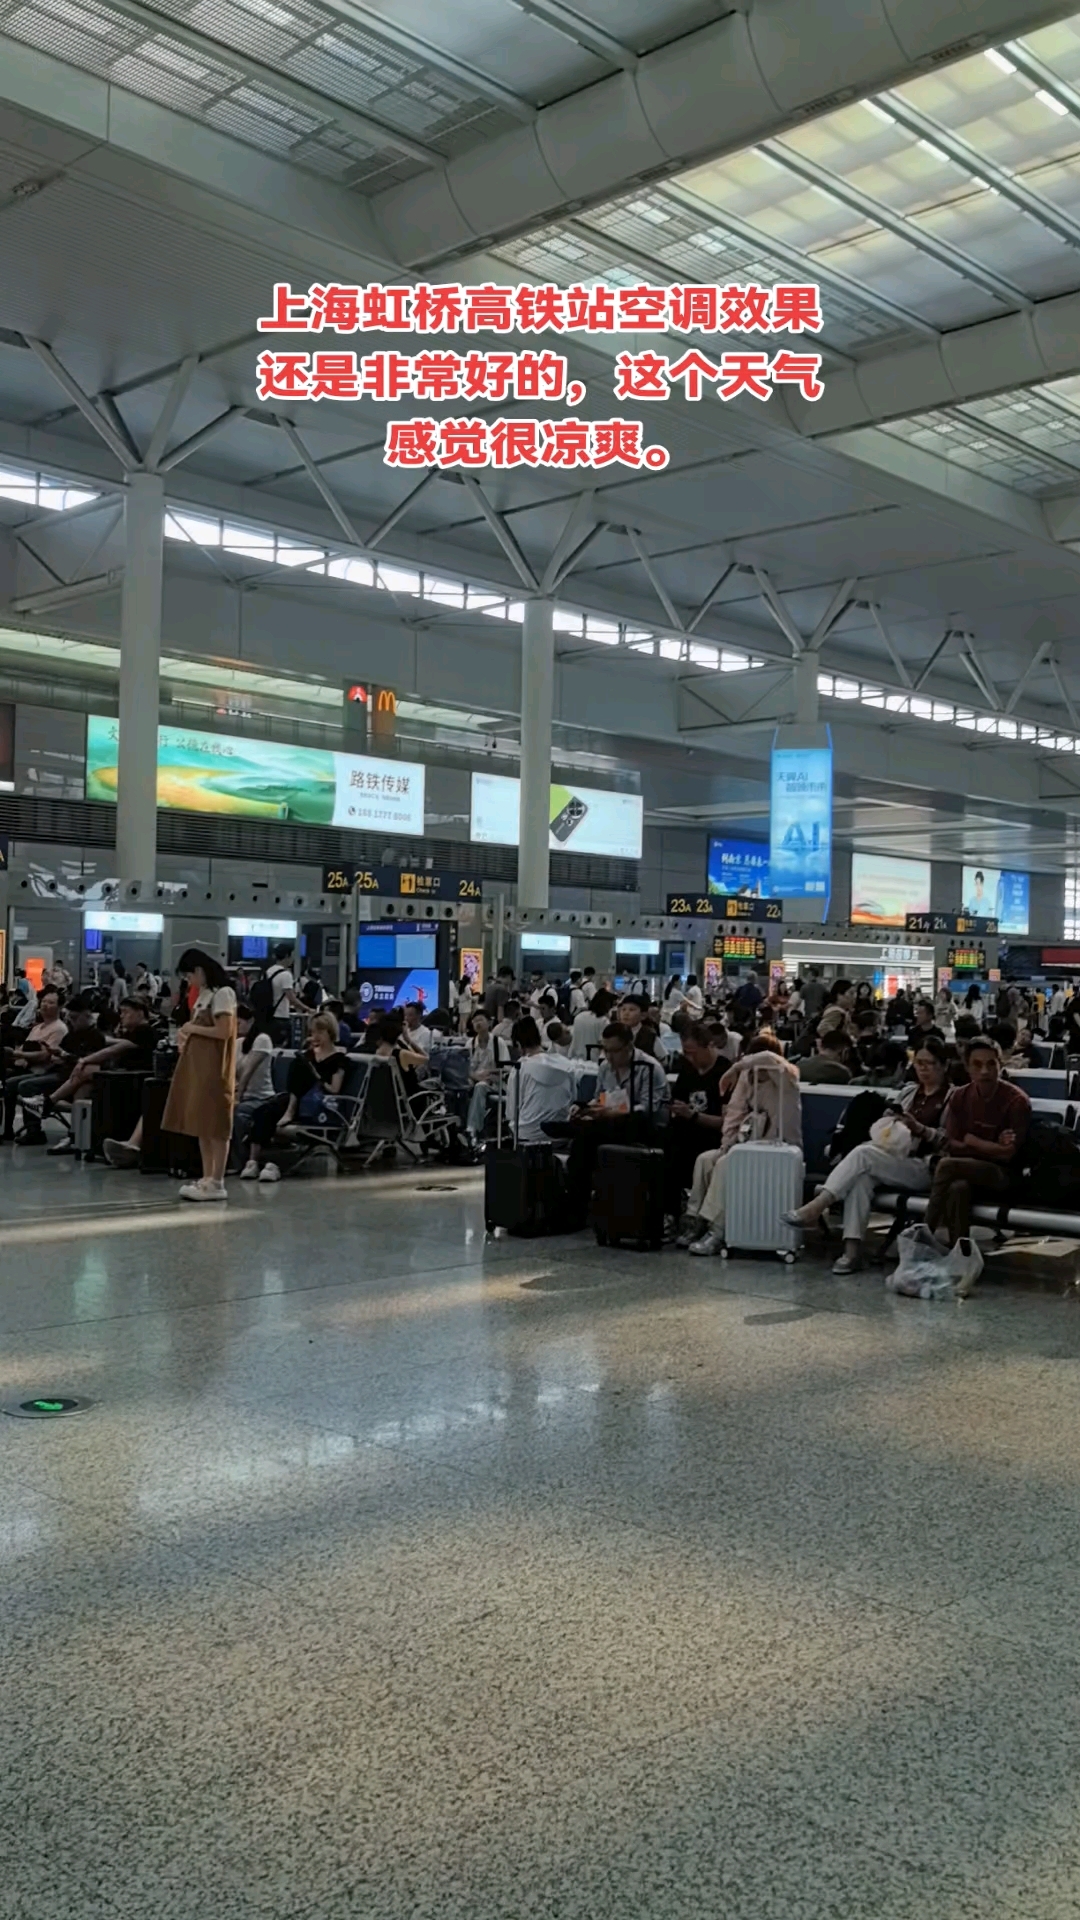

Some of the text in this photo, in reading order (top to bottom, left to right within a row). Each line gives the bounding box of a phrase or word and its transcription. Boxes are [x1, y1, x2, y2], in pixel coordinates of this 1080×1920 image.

[350, 770, 410, 794] 路铁传媒
[327, 871, 349, 889] 25A
[354, 870, 379, 889] 25A
[417, 875, 441, 887] 检票口
[459, 880, 481, 897] 24A
[670, 898, 691, 913] 23A
[696, 898, 713, 914] 23A
